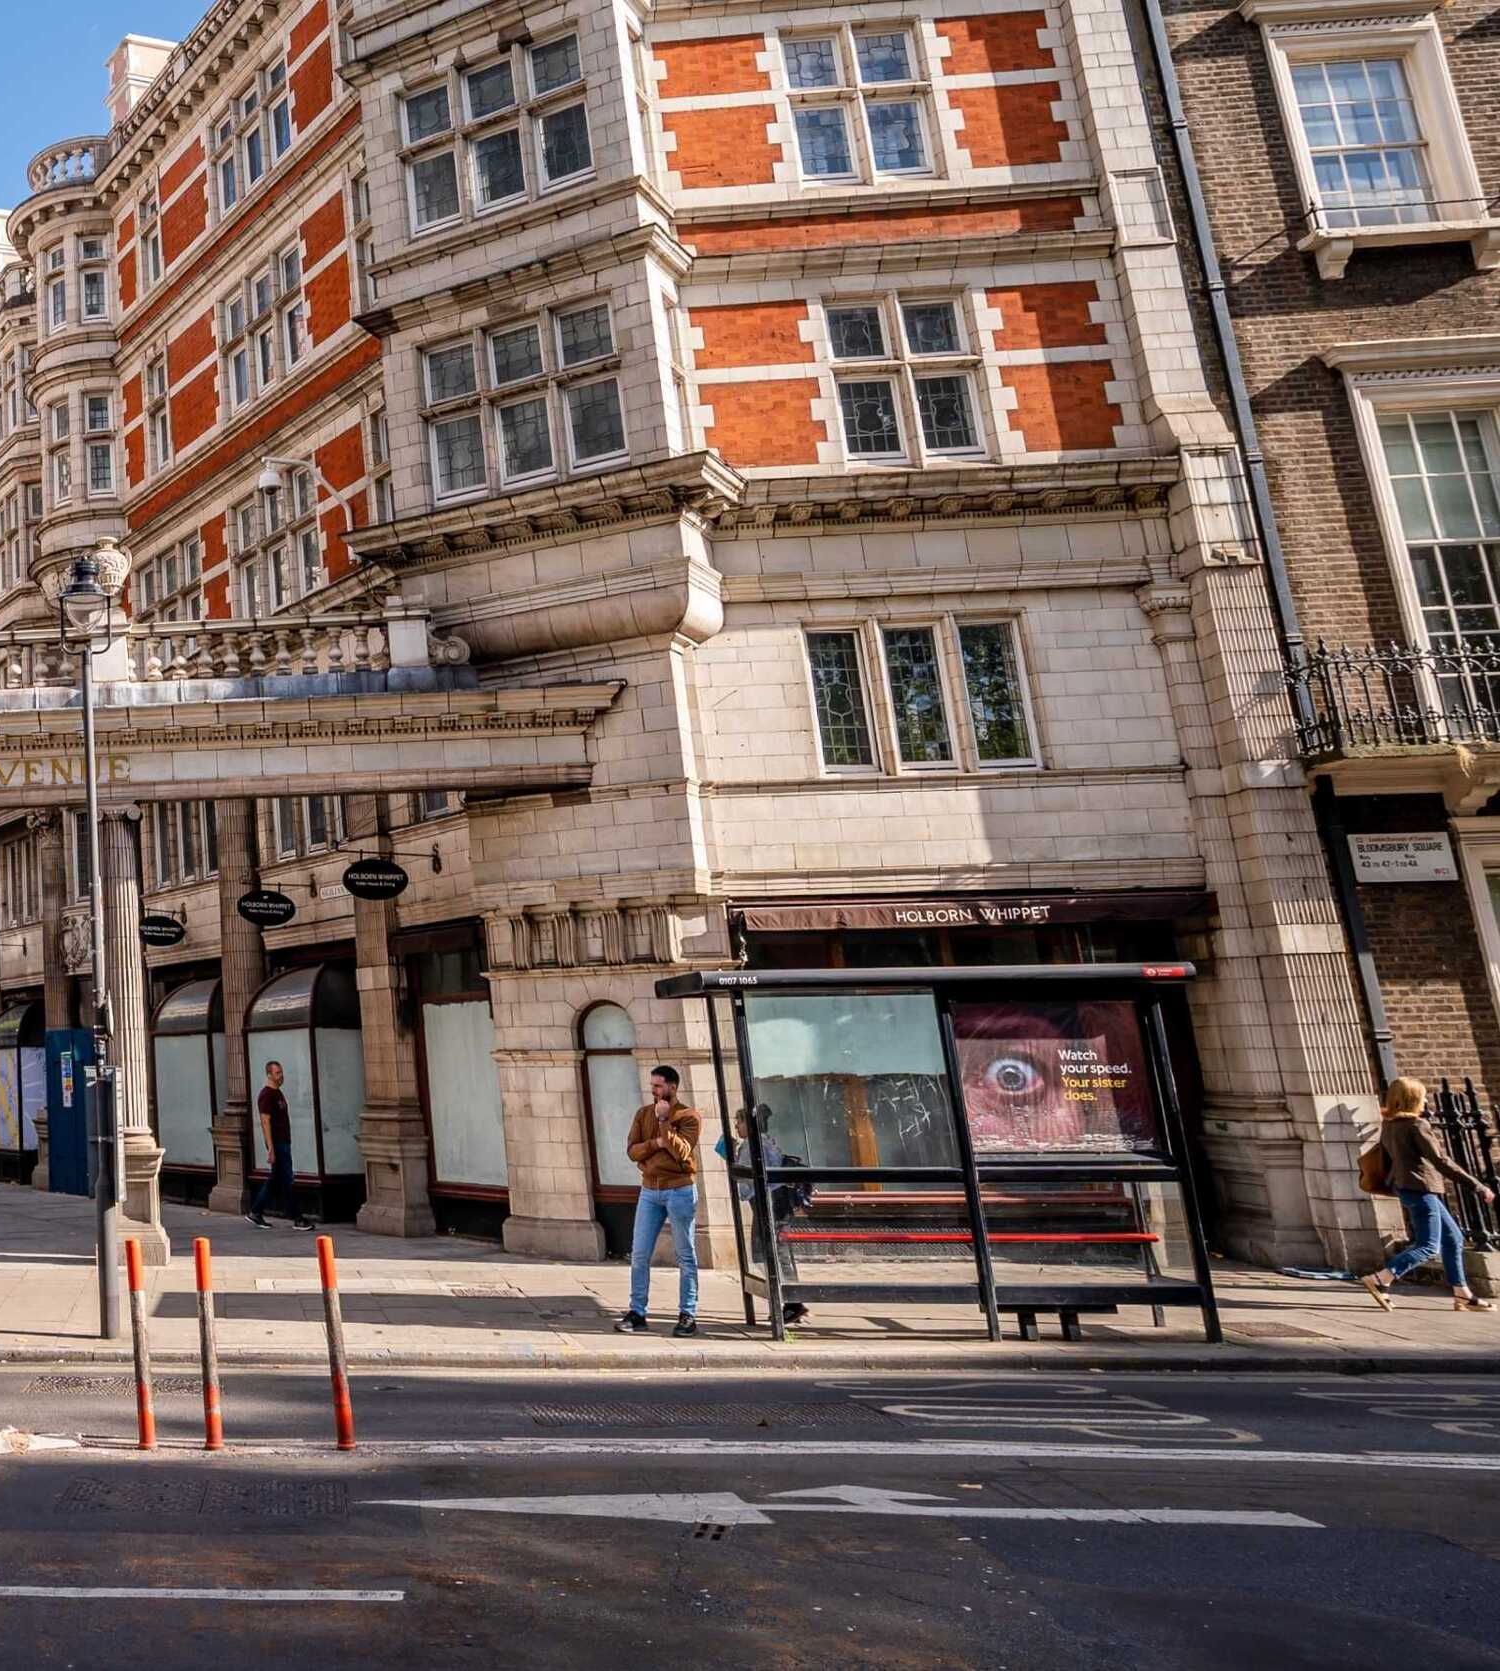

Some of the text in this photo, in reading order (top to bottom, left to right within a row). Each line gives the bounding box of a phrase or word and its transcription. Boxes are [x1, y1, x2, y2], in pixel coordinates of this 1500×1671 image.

[1357, 842, 1444, 853] BLOOMSBURY SQUARE
[895, 905, 1051, 923] HOLBORN WHIPPET
[1058, 1049, 1098, 1060] Watch
[1060, 1062, 1132, 1076] your speed.
[1061, 1077, 1126, 1088] Your sister
[1064, 1090, 1098, 1101] does.
[814, 1381, 1263, 1443] STOP
